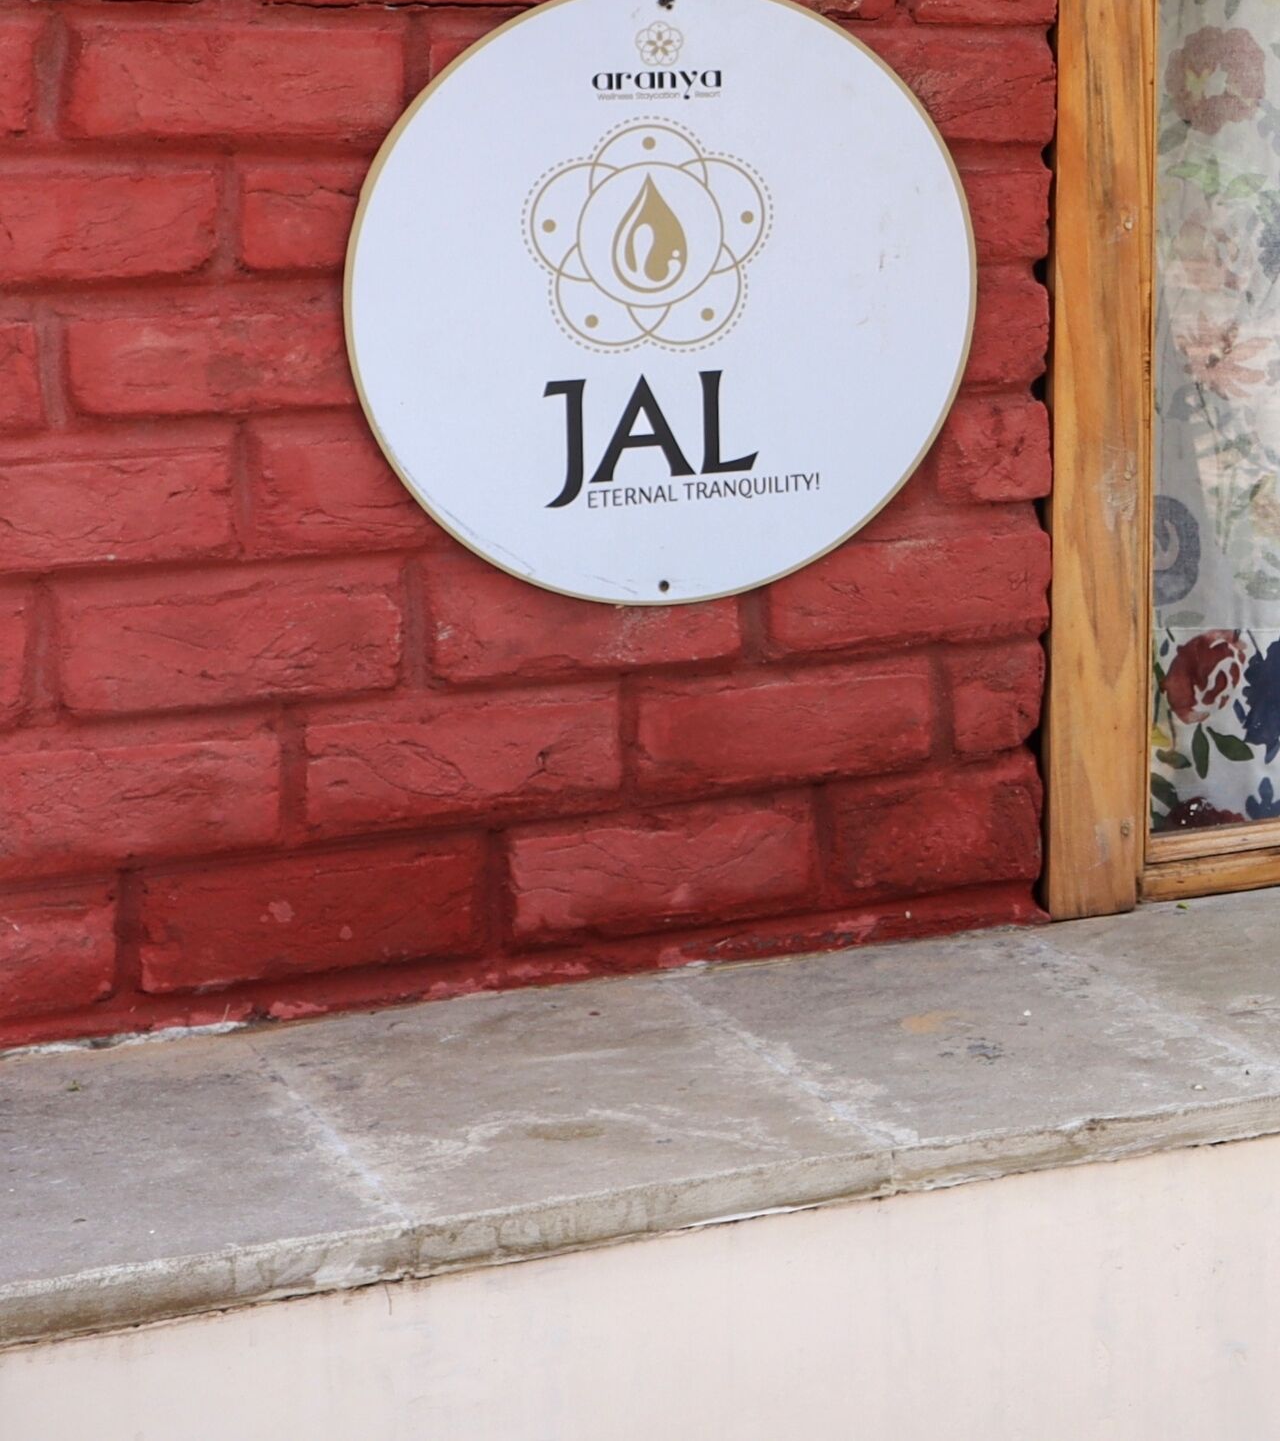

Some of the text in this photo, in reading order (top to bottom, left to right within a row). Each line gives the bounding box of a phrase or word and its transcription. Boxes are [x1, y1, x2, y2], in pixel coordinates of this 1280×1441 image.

[592, 70, 722, 100] aranya
[543, 369, 759, 508] JAL
[587, 472, 821, 509] ETERNAL TRANQUILITY!
